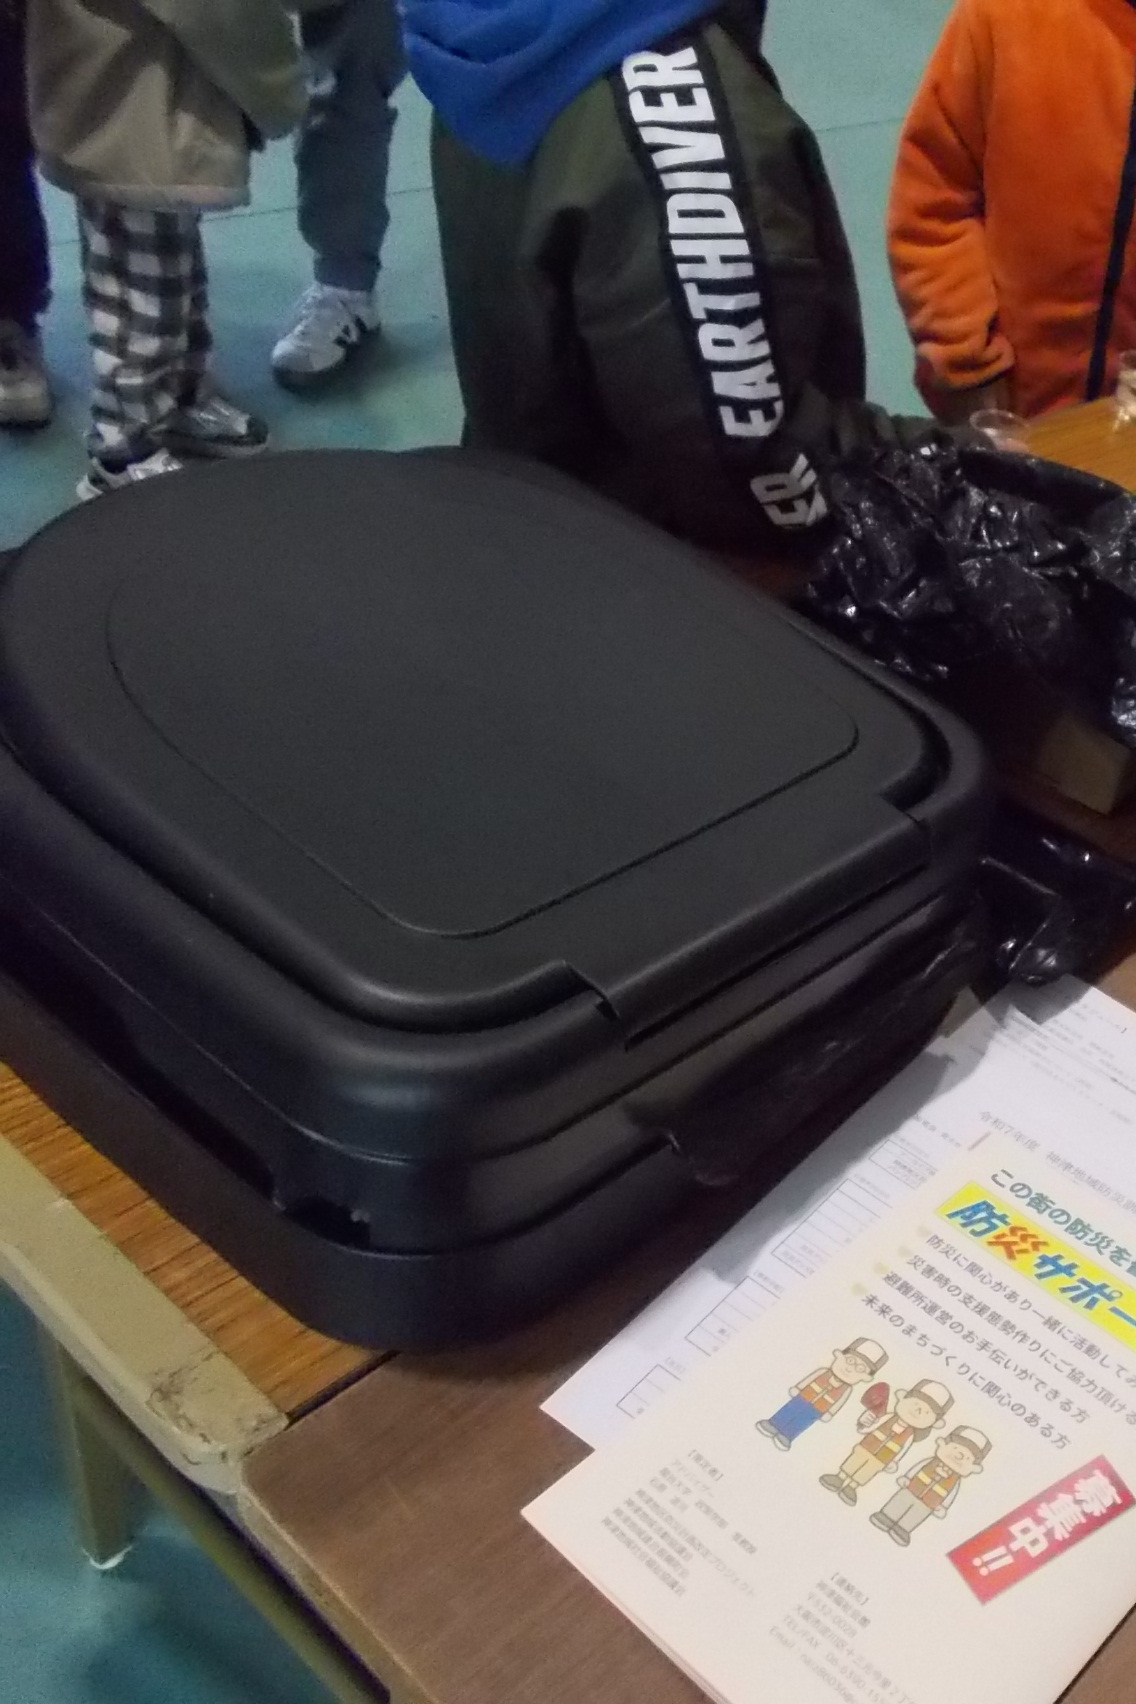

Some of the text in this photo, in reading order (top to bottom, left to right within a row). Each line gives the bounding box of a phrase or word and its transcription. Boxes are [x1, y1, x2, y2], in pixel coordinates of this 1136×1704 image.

[622, 47, 785, 438] EARTHDIVER
[862, 1294, 1072, 1450] 未来のまちづくりに関心のある方
[882, 1270, 1091, 1424] 避難所運営のお手伝いができる方
[972, 1469, 1122, 1576] 募集中!!
